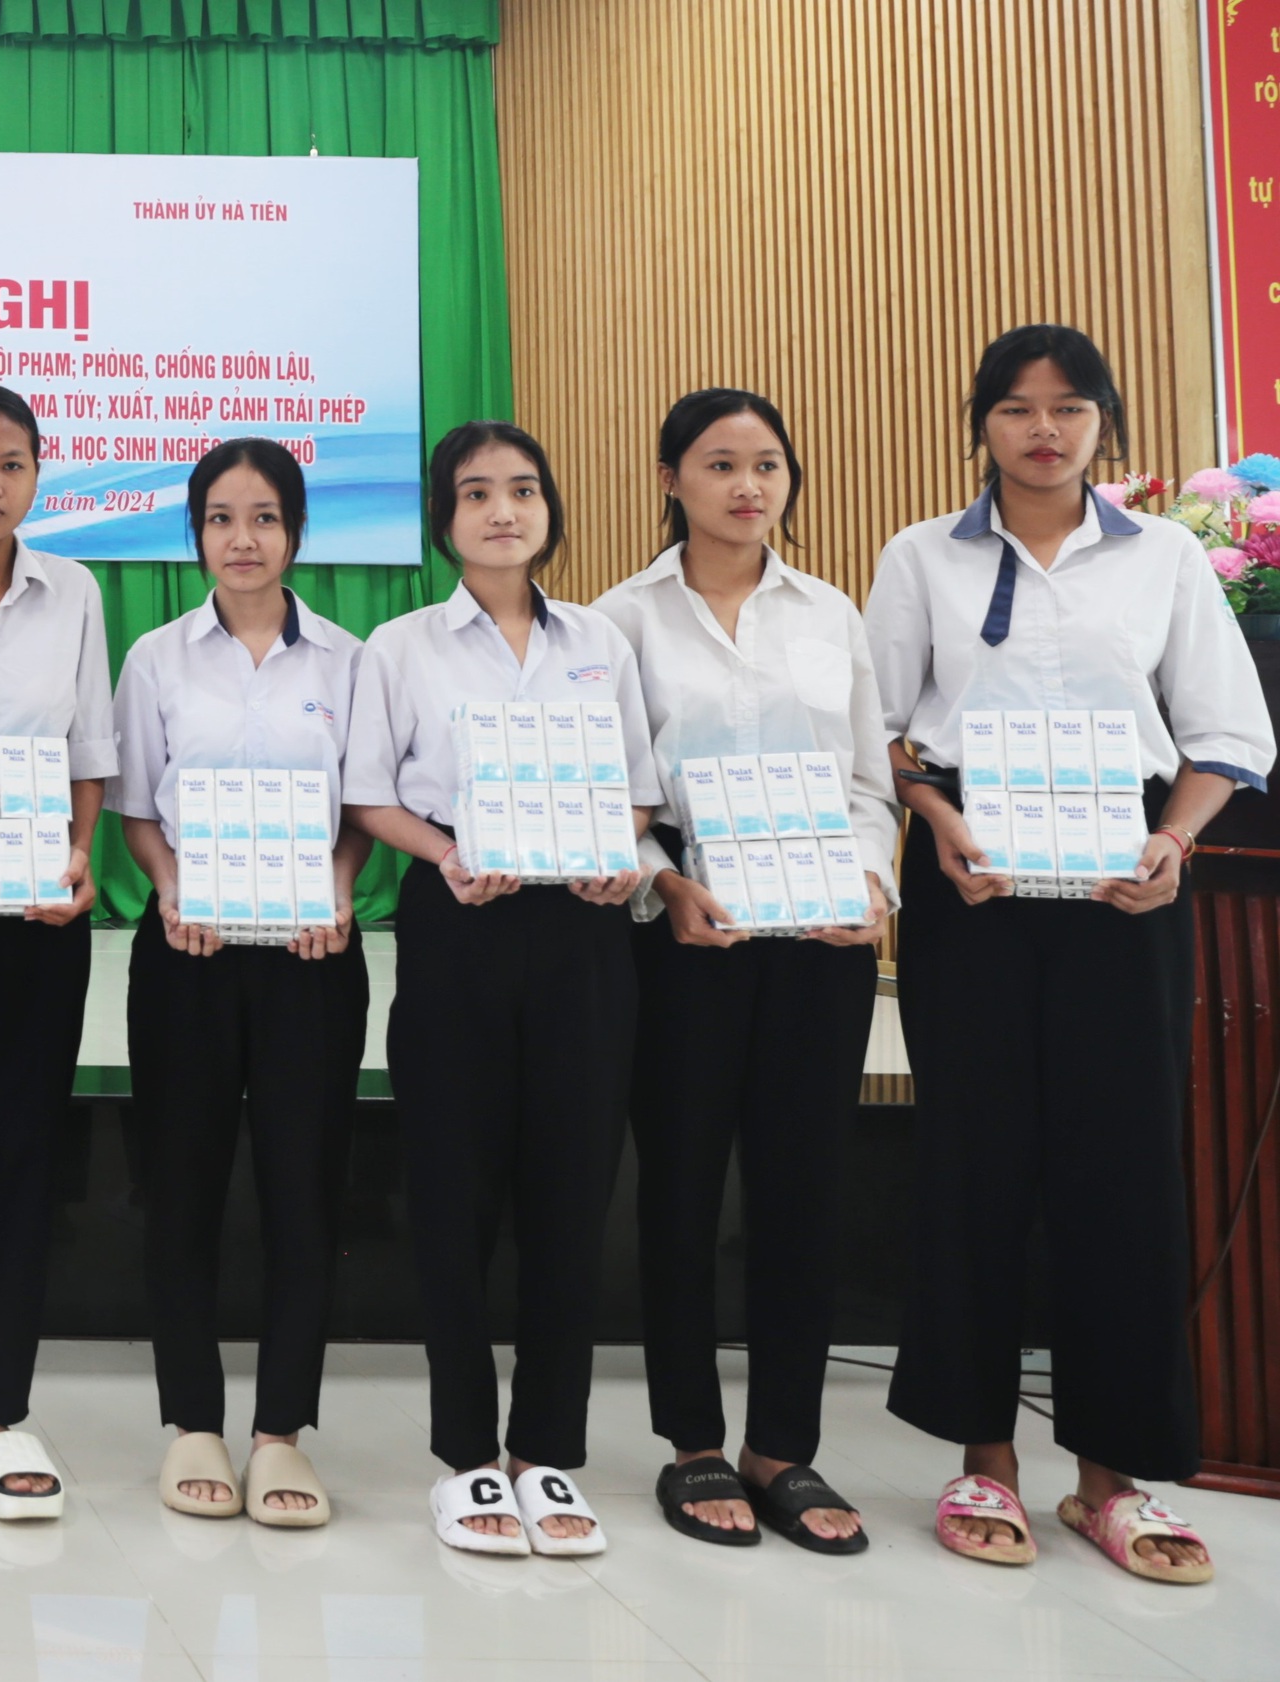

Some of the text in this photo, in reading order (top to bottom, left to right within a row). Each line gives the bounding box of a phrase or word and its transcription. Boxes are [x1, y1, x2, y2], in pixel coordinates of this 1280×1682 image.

[1254, 74, 1280, 108] rộ
[1248, 176, 1274, 209] tự
[134, 196, 287, 222] THÀNH ỦY HÀ TIÊN
[19, 351, 77, 382] PHẠM;
[83, 350, 149, 380] PHÒNG,
[155, 345, 215, 380] CHỐNG
[222, 351, 270, 380] BUÔN
[277, 351, 315, 384] LẬU,
[30, 393, 58, 418] MA
[64, 390, 101, 420] TÚY;
[108, 387, 158, 422] XUẤT,
[165, 392, 213, 427] NHẬP
[219, 387, 267, 421] CẢNH
[275, 394, 313, 422] TRÁI
[320, 393, 365, 423] PHÉP
[72, 438, 107, 466] HỌC
[113, 438, 156, 462] SINH
[45, 488, 96, 511] năm
[104, 490, 156, 511] 2024
[470, 1477, 503, 1505] C
[540, 1475, 574, 1505] C
